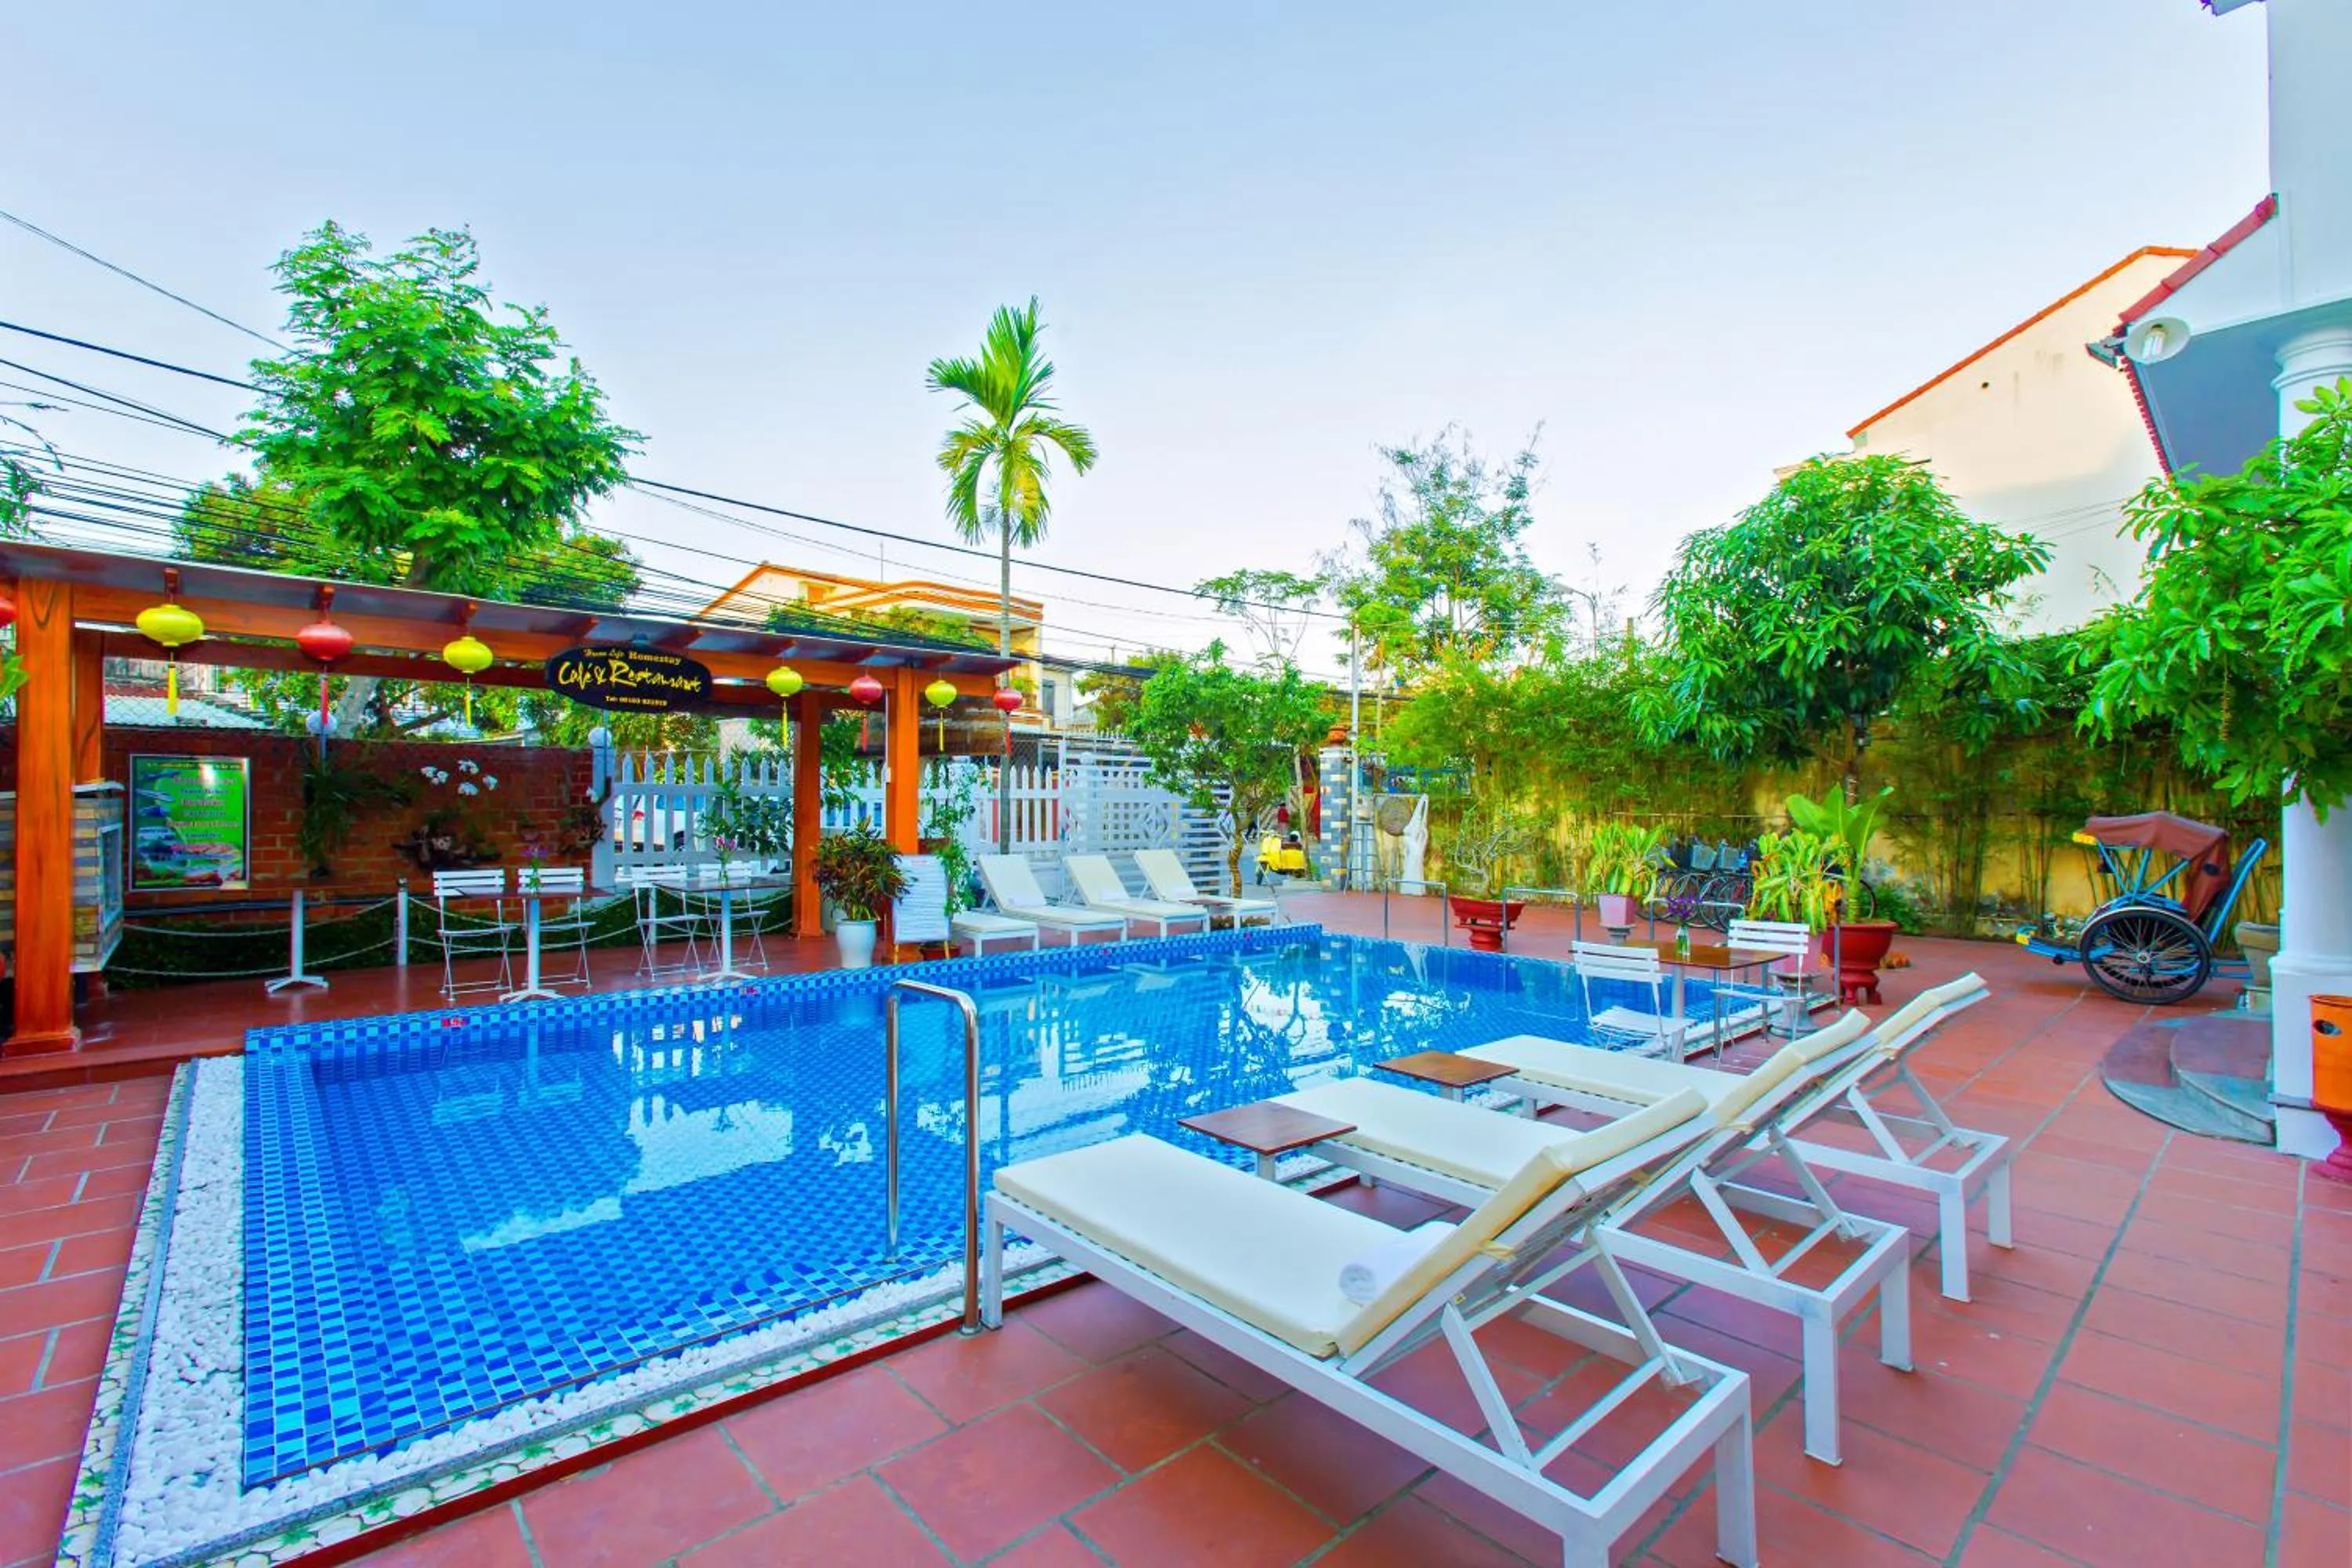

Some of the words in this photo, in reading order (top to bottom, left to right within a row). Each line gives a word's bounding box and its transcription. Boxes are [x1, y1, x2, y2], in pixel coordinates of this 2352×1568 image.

[629, 650, 681, 665] Homestay
[558, 660, 593, 690] Café
[608, 659, 702, 692] Restaurant
